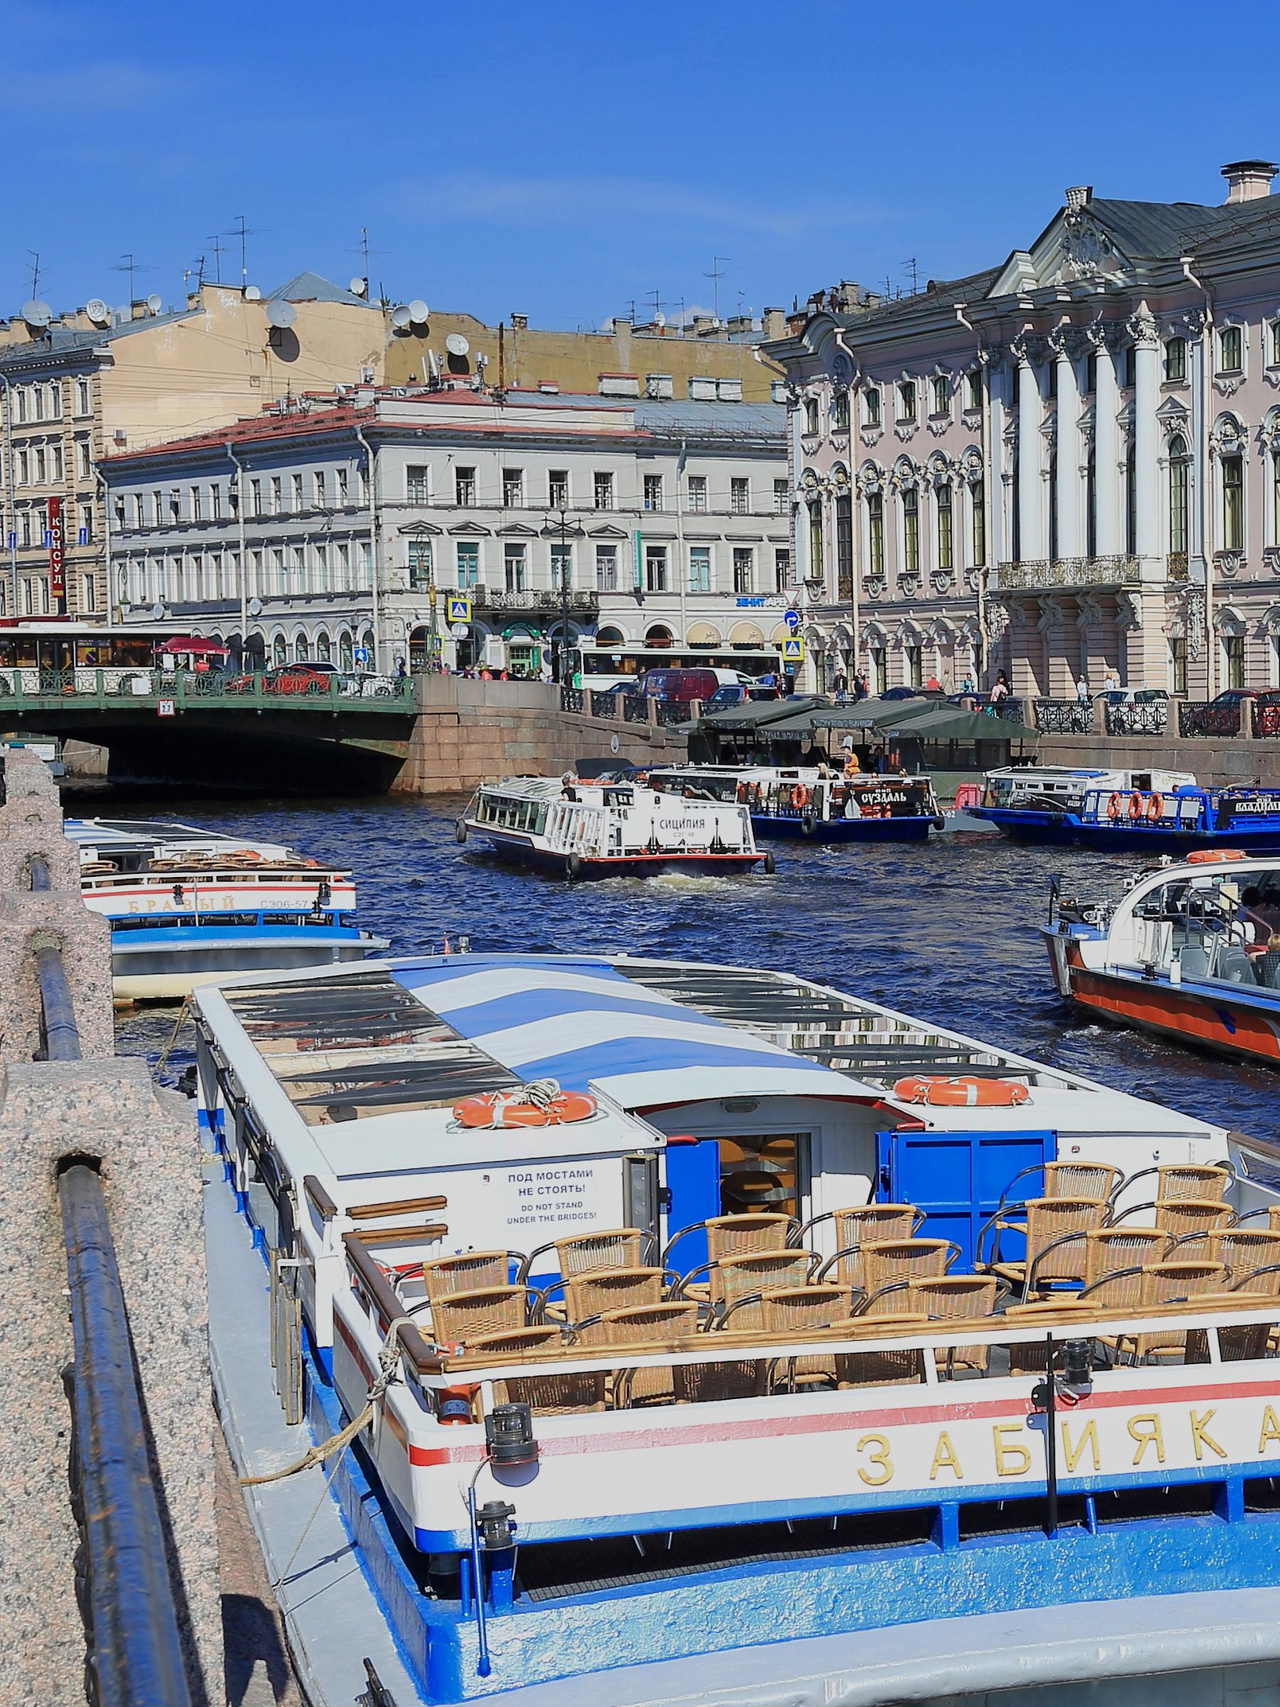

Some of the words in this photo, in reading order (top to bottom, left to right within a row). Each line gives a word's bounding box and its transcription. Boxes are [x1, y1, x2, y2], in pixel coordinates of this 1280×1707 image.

[51, 517, 63, 585] КОНСУЛ
[861, 792, 907, 805] СУЗДАЛЬ
[660, 818, 705, 831] СИЦИЛИЯ
[127, 895, 235, 914] БРАВЫЙ
[508, 1173, 533, 1183] ПОД
[536, 1169, 593, 1181] МОСТАМИ
[518, 1187, 534, 1196] НЕ
[537, 1184, 586, 1195] СТОЯТЬ!
[521, 1204, 533, 1212] DO
[535, 1203, 553, 1211] NOT
[555, 1201, 583, 1210] STAND
[507, 1216, 536, 1225] UNDER
[538, 1214, 555, 1223] THE
[557, 1212, 597, 1221] BRIDGES!
